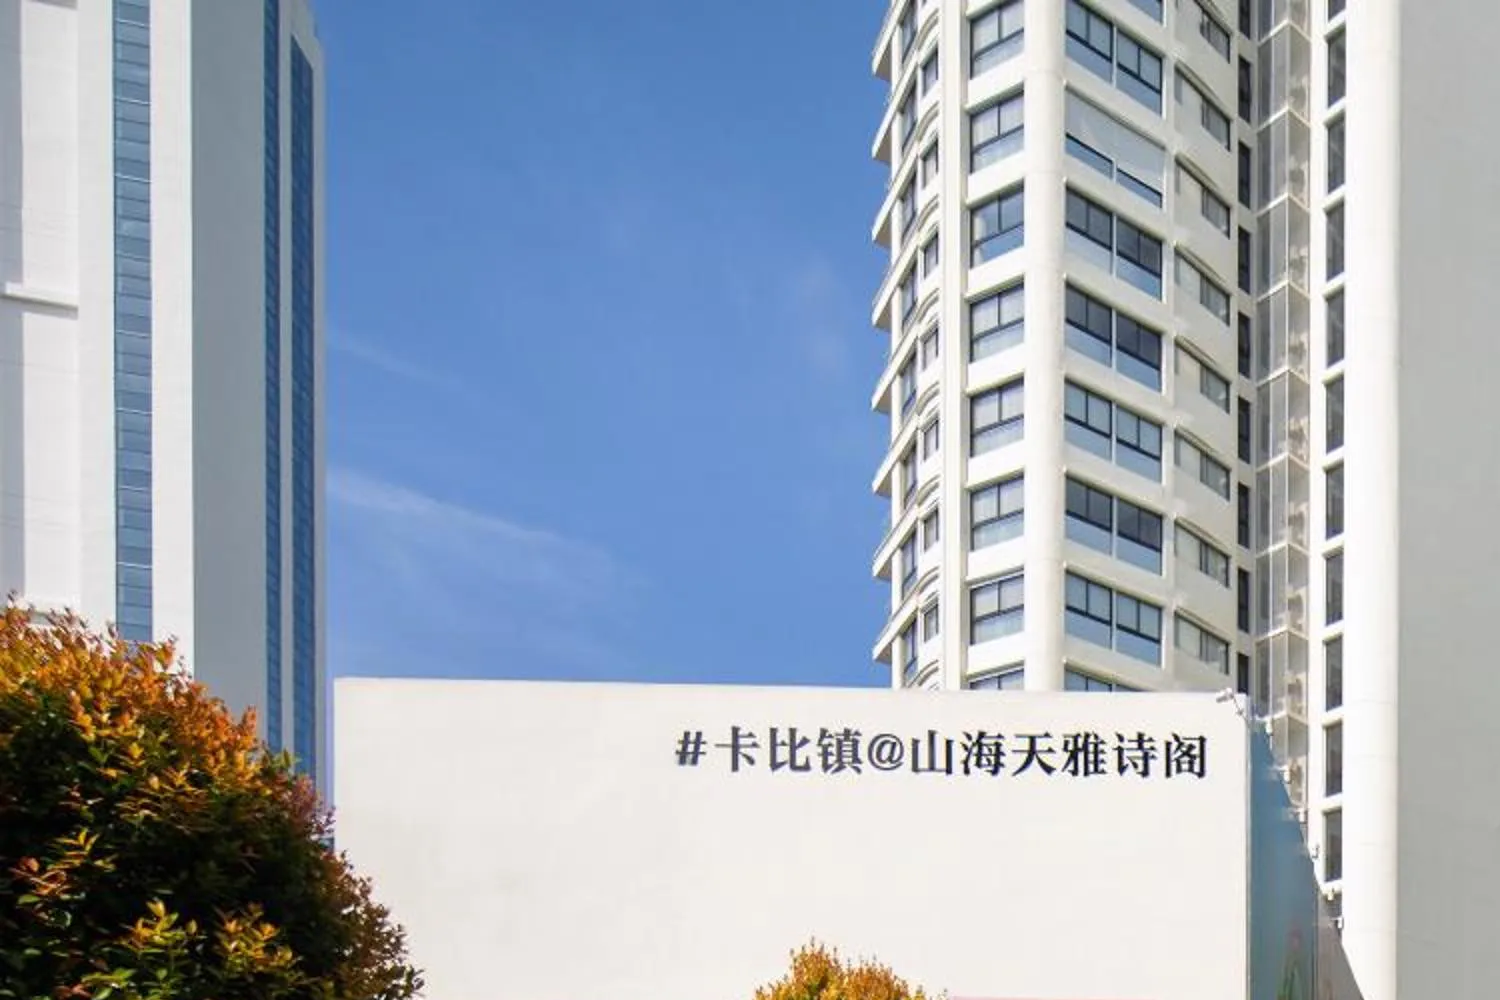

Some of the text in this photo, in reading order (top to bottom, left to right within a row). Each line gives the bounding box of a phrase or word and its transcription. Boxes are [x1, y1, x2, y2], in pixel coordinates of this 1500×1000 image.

[675, 725, 1208, 780] #卡比镇@山海天雅诗阁
